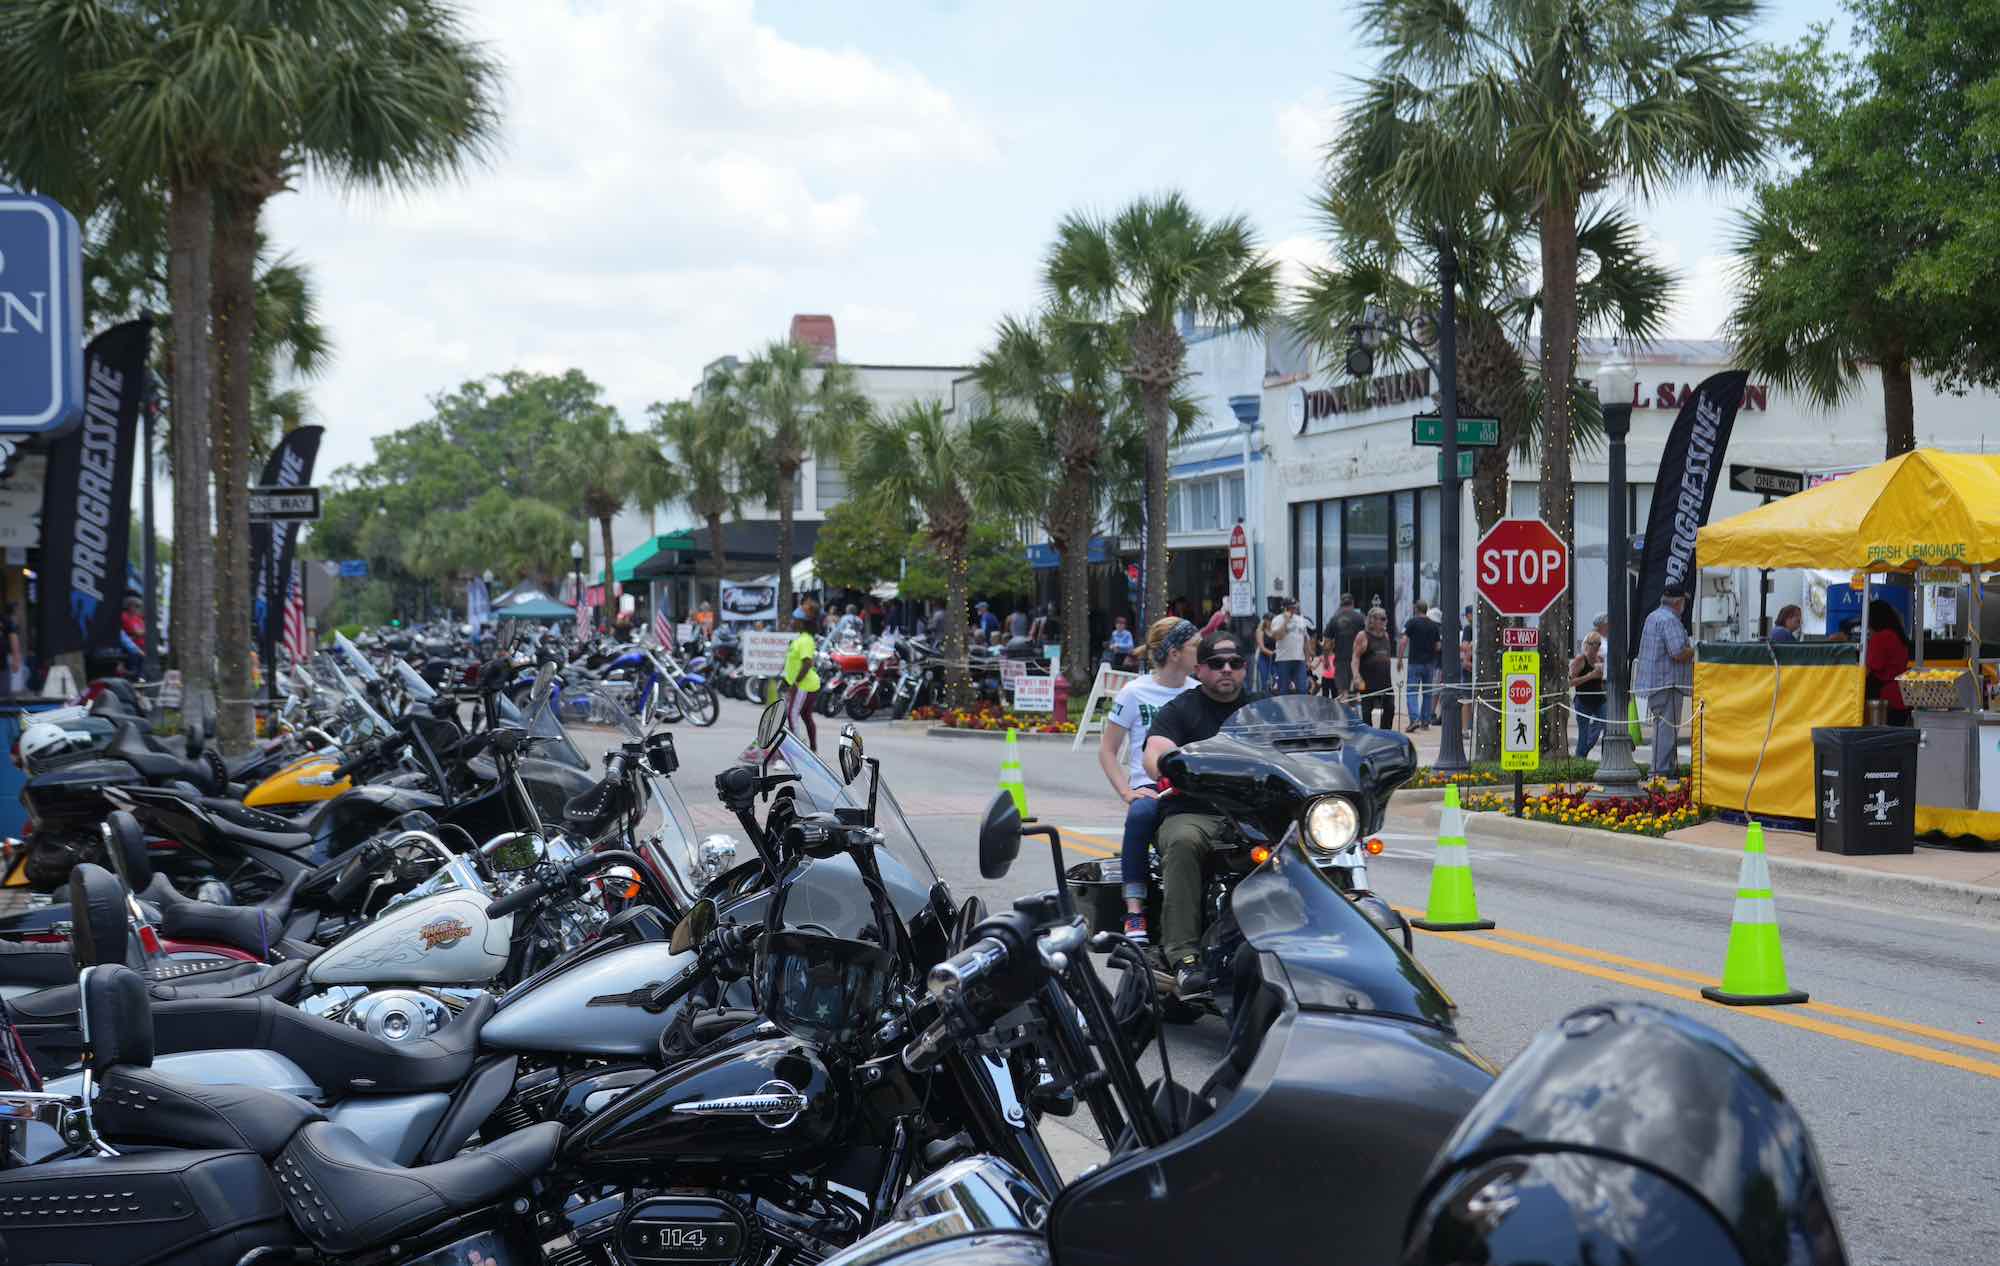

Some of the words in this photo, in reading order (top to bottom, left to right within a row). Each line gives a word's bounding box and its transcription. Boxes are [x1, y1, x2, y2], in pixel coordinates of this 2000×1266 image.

[1656, 382, 1769, 411] SAN
[1480, 431, 1495, 441] 100
[71, 357, 124, 601] PROGRESSIVE
[1755, 475, 1775, 490] ONE
[1779, 479, 1798, 493] WAY
[1867, 545, 1901, 559] FRESH
[1906, 543, 1966, 558] LEMONADE
[1481, 549, 1561, 585] STOP
[1509, 655, 1533, 664] STATE
[1513, 664, 1529, 672] LAW
[1510, 687, 1532, 697] STOP
[660, 1228, 707, 1247] 114
